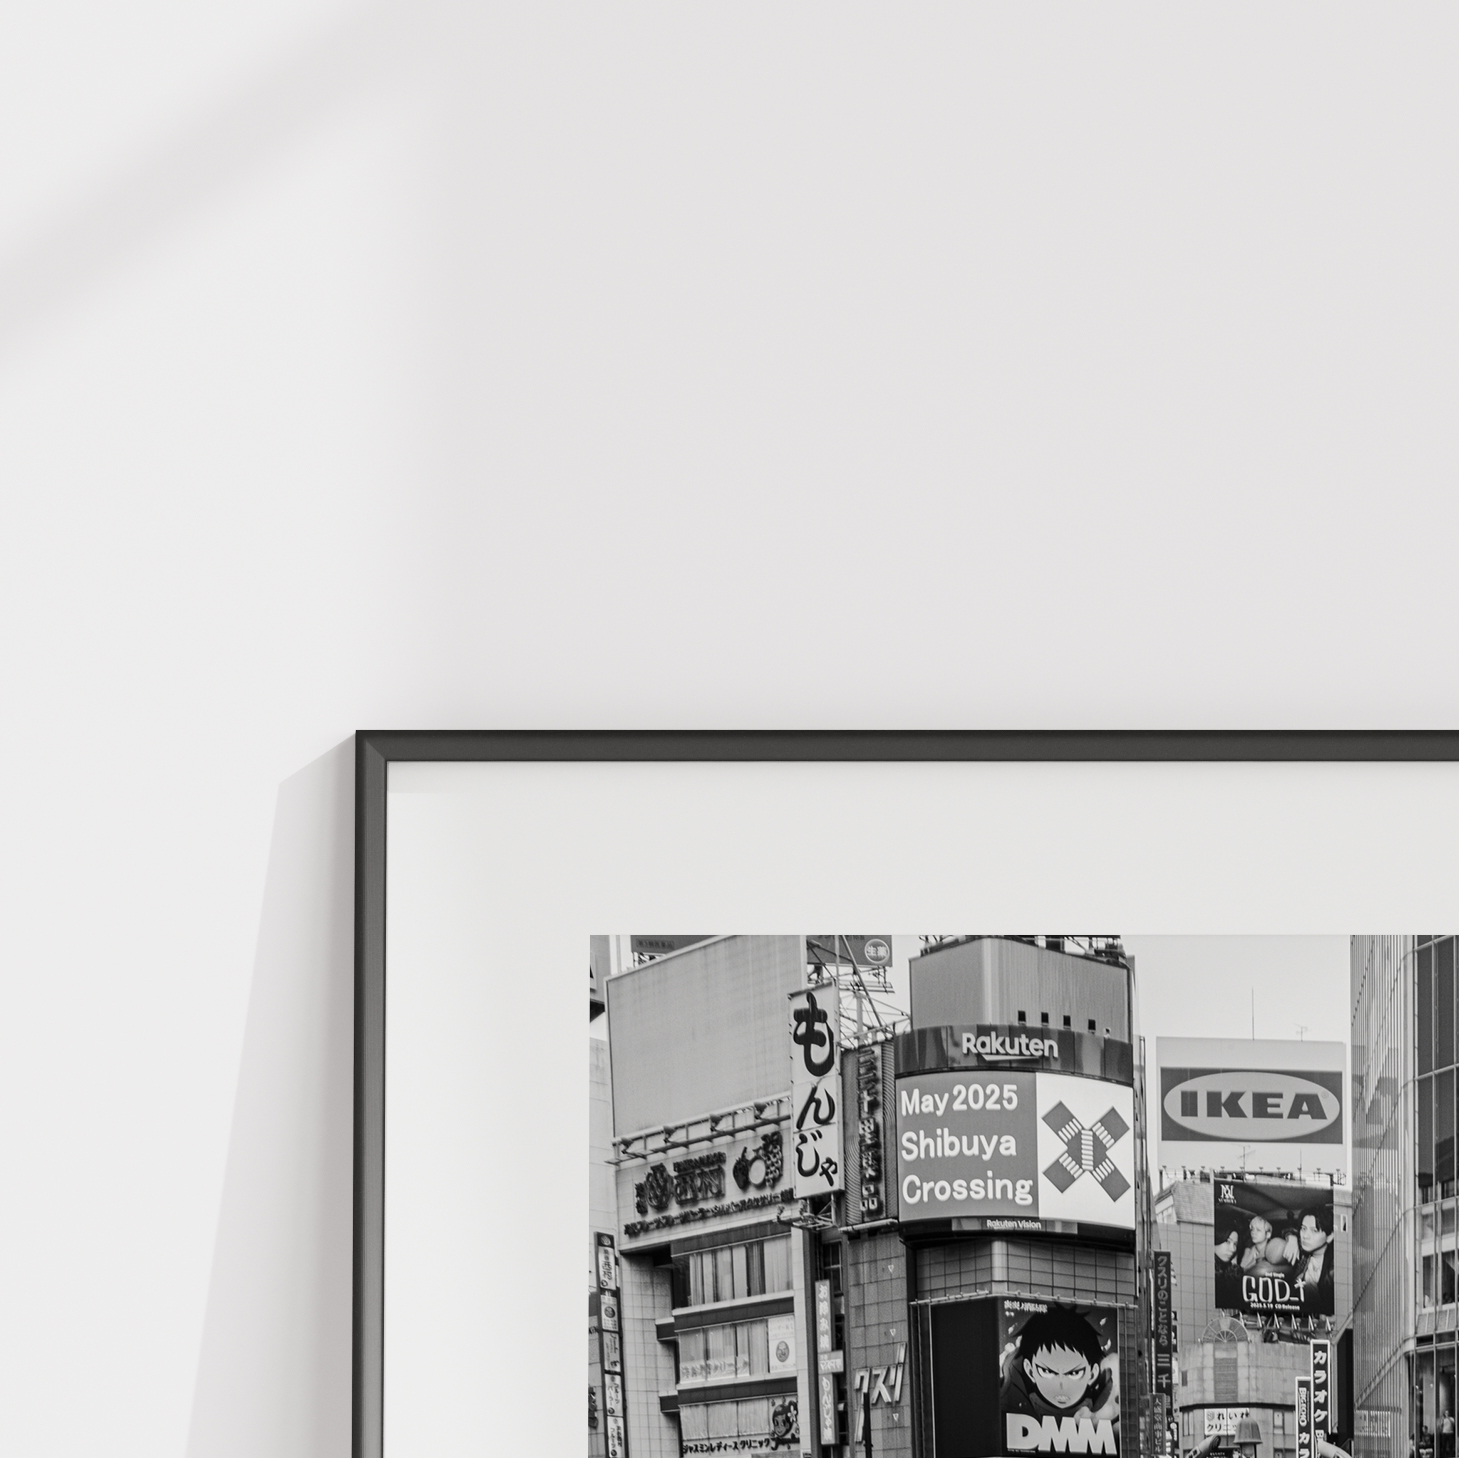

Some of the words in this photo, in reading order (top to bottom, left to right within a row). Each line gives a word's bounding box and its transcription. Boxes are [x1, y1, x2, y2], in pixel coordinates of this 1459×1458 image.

[961, 1031, 1059, 1059] Rakuten
[793, 991, 838, 1187] もんじゃ
[901, 1088, 949, 1117] May
[952, 1083, 1018, 1111] 2025
[1180, 1090, 1328, 1120] IKEA
[901, 1127, 1017, 1161] Shibuya
[902, 1170, 1034, 1206] Crossing
[986, 1219, 1017, 1229] Rakuten
[1018, 1220, 1042, 1230] Vision
[1157, 1255, 1169, 1346] クスリのことなら
[1313, 1350, 1328, 1423] カラオケ
[1006, 1412, 1117, 1455] DMM
